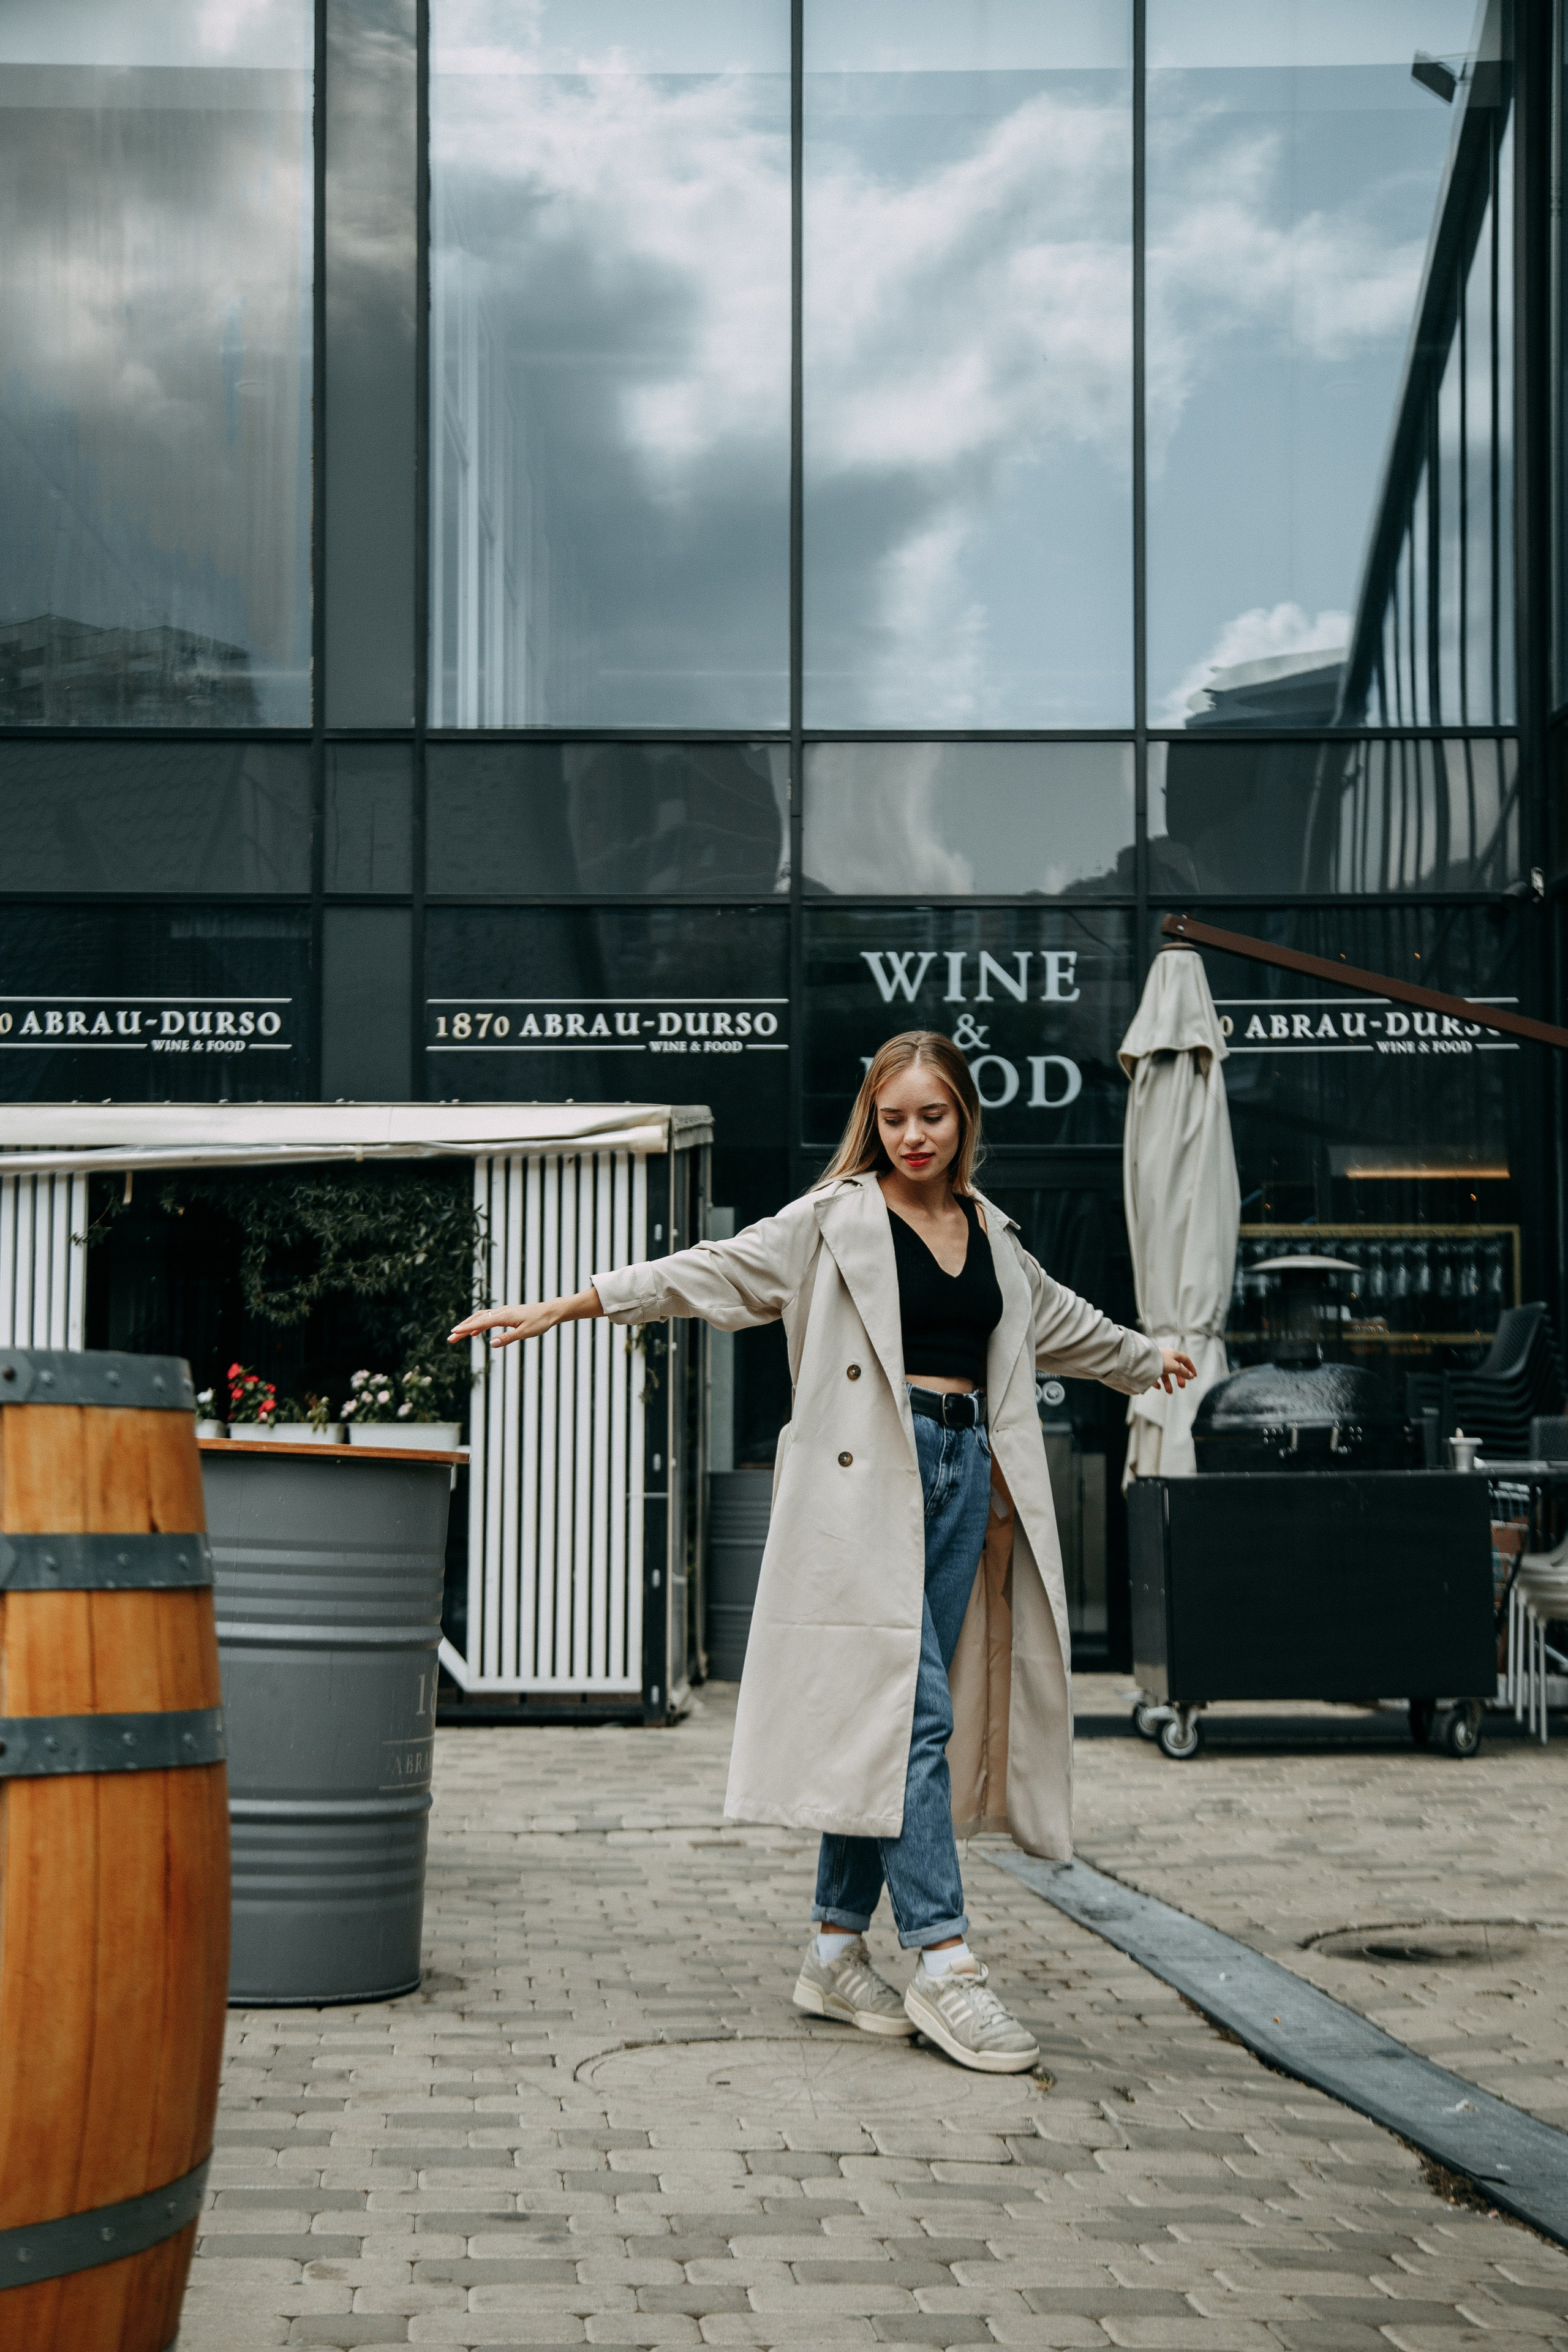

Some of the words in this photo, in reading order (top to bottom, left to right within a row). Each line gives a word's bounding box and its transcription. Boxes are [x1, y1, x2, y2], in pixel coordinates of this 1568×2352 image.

[859, 951, 1080, 1003] WINE
[18, 1011, 281, 1036] ABRAU-DURSO
[435, 1012, 510, 1039] 1870
[519, 1012, 778, 1036] ABRAU-DURSO
[952, 1014, 990, 1049] &
[152, 1040, 190, 1052] WINE
[192, 1040, 204, 1053] &
[206, 1040, 246, 1053] FOOD
[649, 1041, 687, 1053] WINE
[689, 1041, 702, 1054] &
[703, 1041, 743, 1053] FOOD
[1376, 1041, 1415, 1054] WINE
[1417, 1041, 1430, 1054] &
[1432, 1041, 1473, 1054] FOOD
[860, 1055, 1082, 1109] OD
